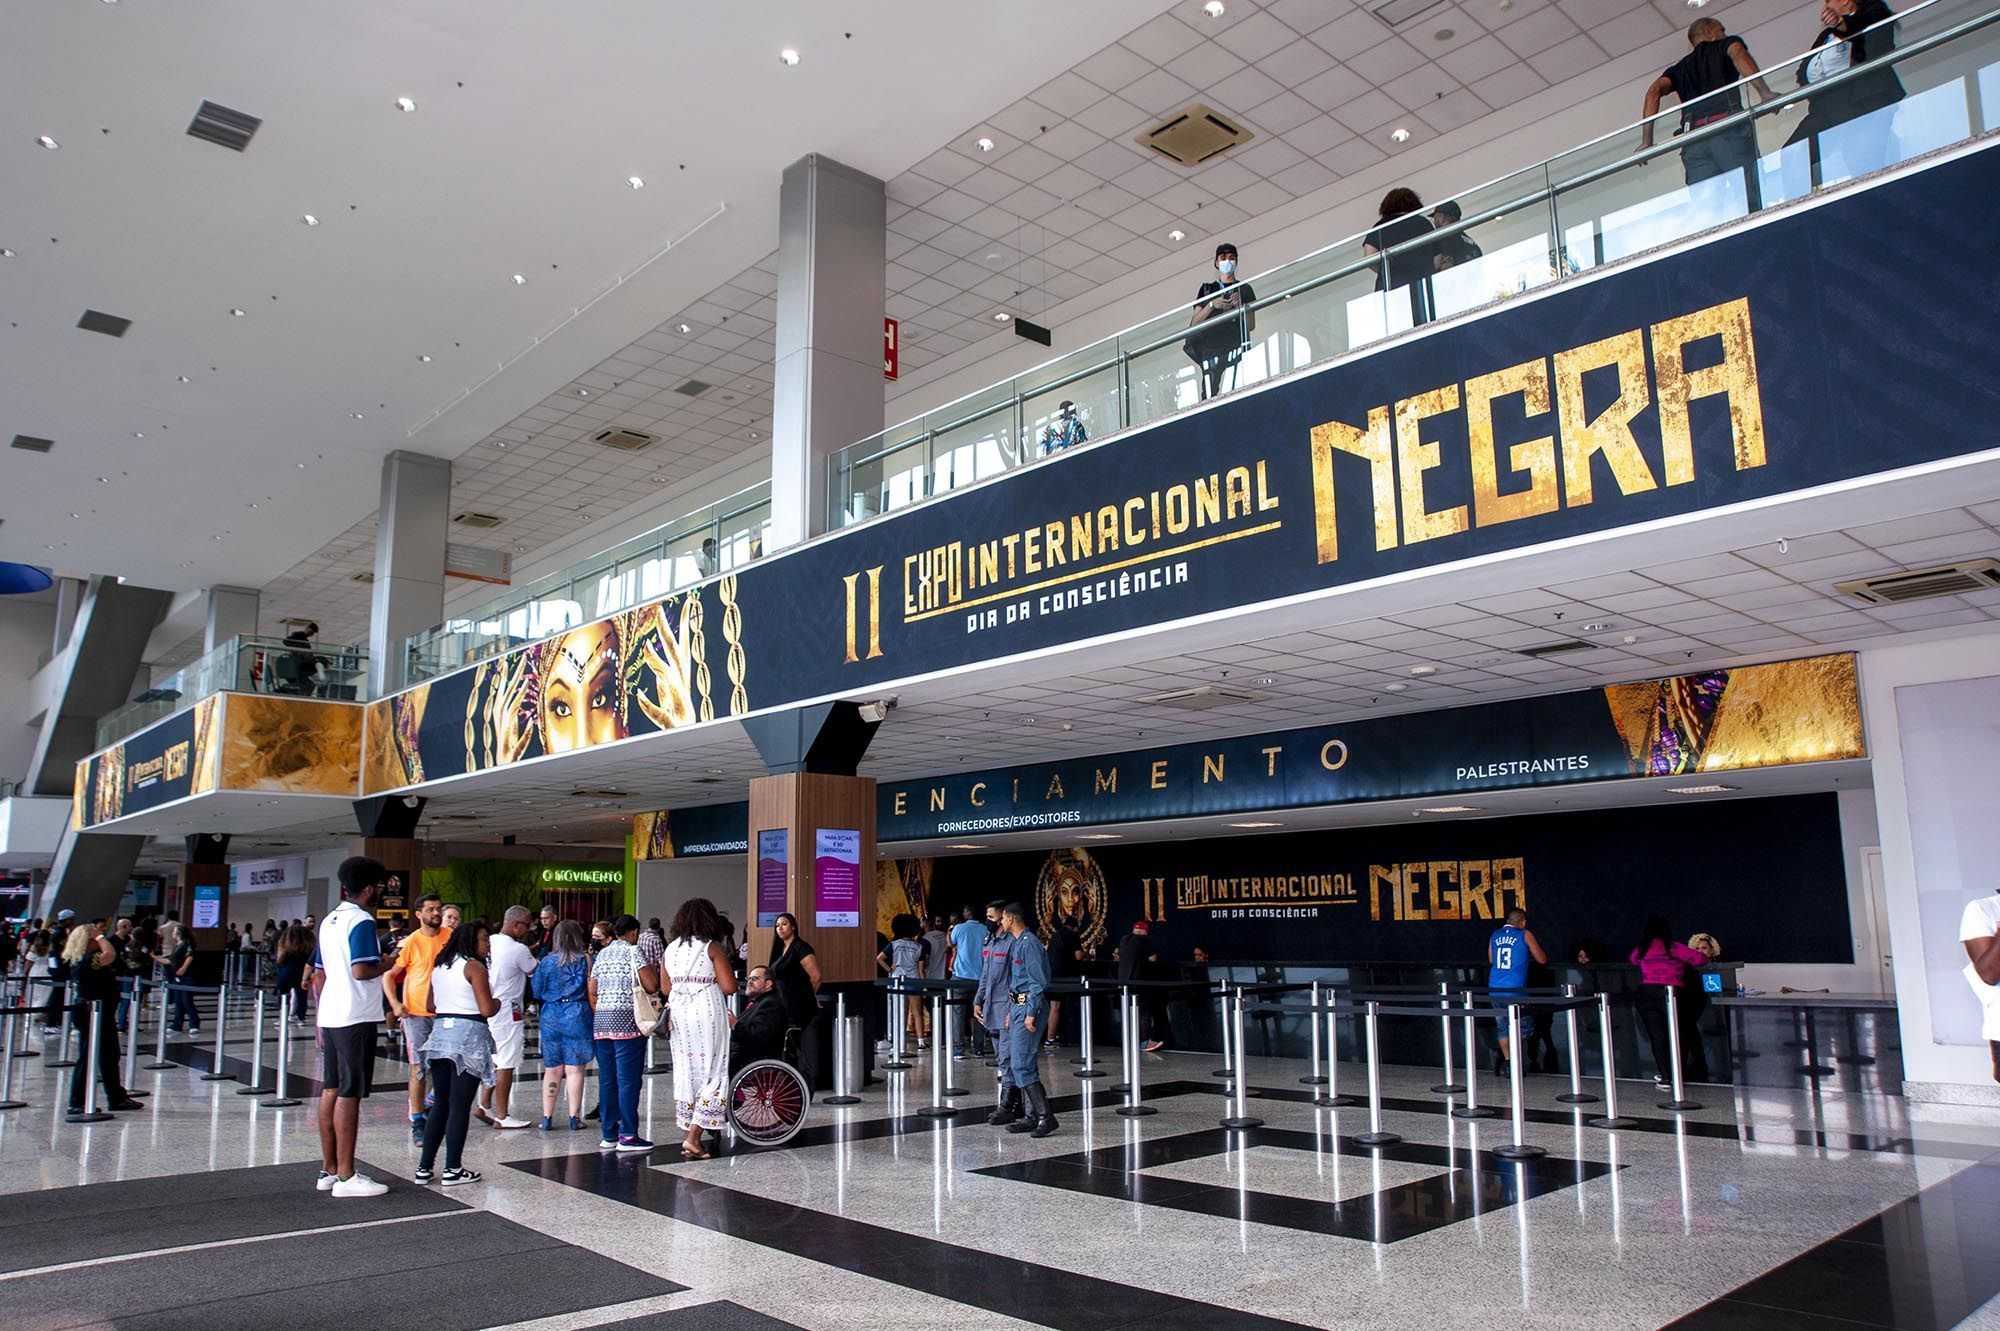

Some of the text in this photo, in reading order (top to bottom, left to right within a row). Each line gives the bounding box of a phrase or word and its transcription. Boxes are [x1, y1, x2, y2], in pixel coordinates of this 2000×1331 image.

[1310, 296, 1767, 564] NEGRA
[842, 459, 1280, 665] II EXPO INTERNACIONAL
[967, 561, 1188, 634] DIA DA CONSCIÊNCIA
[894, 738, 1349, 816] ENCIAMENTO
[1455, 754, 1590, 781] PALESTRANTES
[937, 810, 1081, 833] FORNECEDORES/EXPOSITORES
[683, 840, 748, 854] IMPRENSA/CONVIDADOS
[542, 869, 623, 883] O MOVIMENTO
[1368, 857, 1528, 921] NEGRA
[1141, 872, 1358, 922] II EXPO INTERNACIONAL
[1211, 906, 1319, 919] DIA DA CONSCIÊNCIA
[1497, 947, 1511, 969] 13
